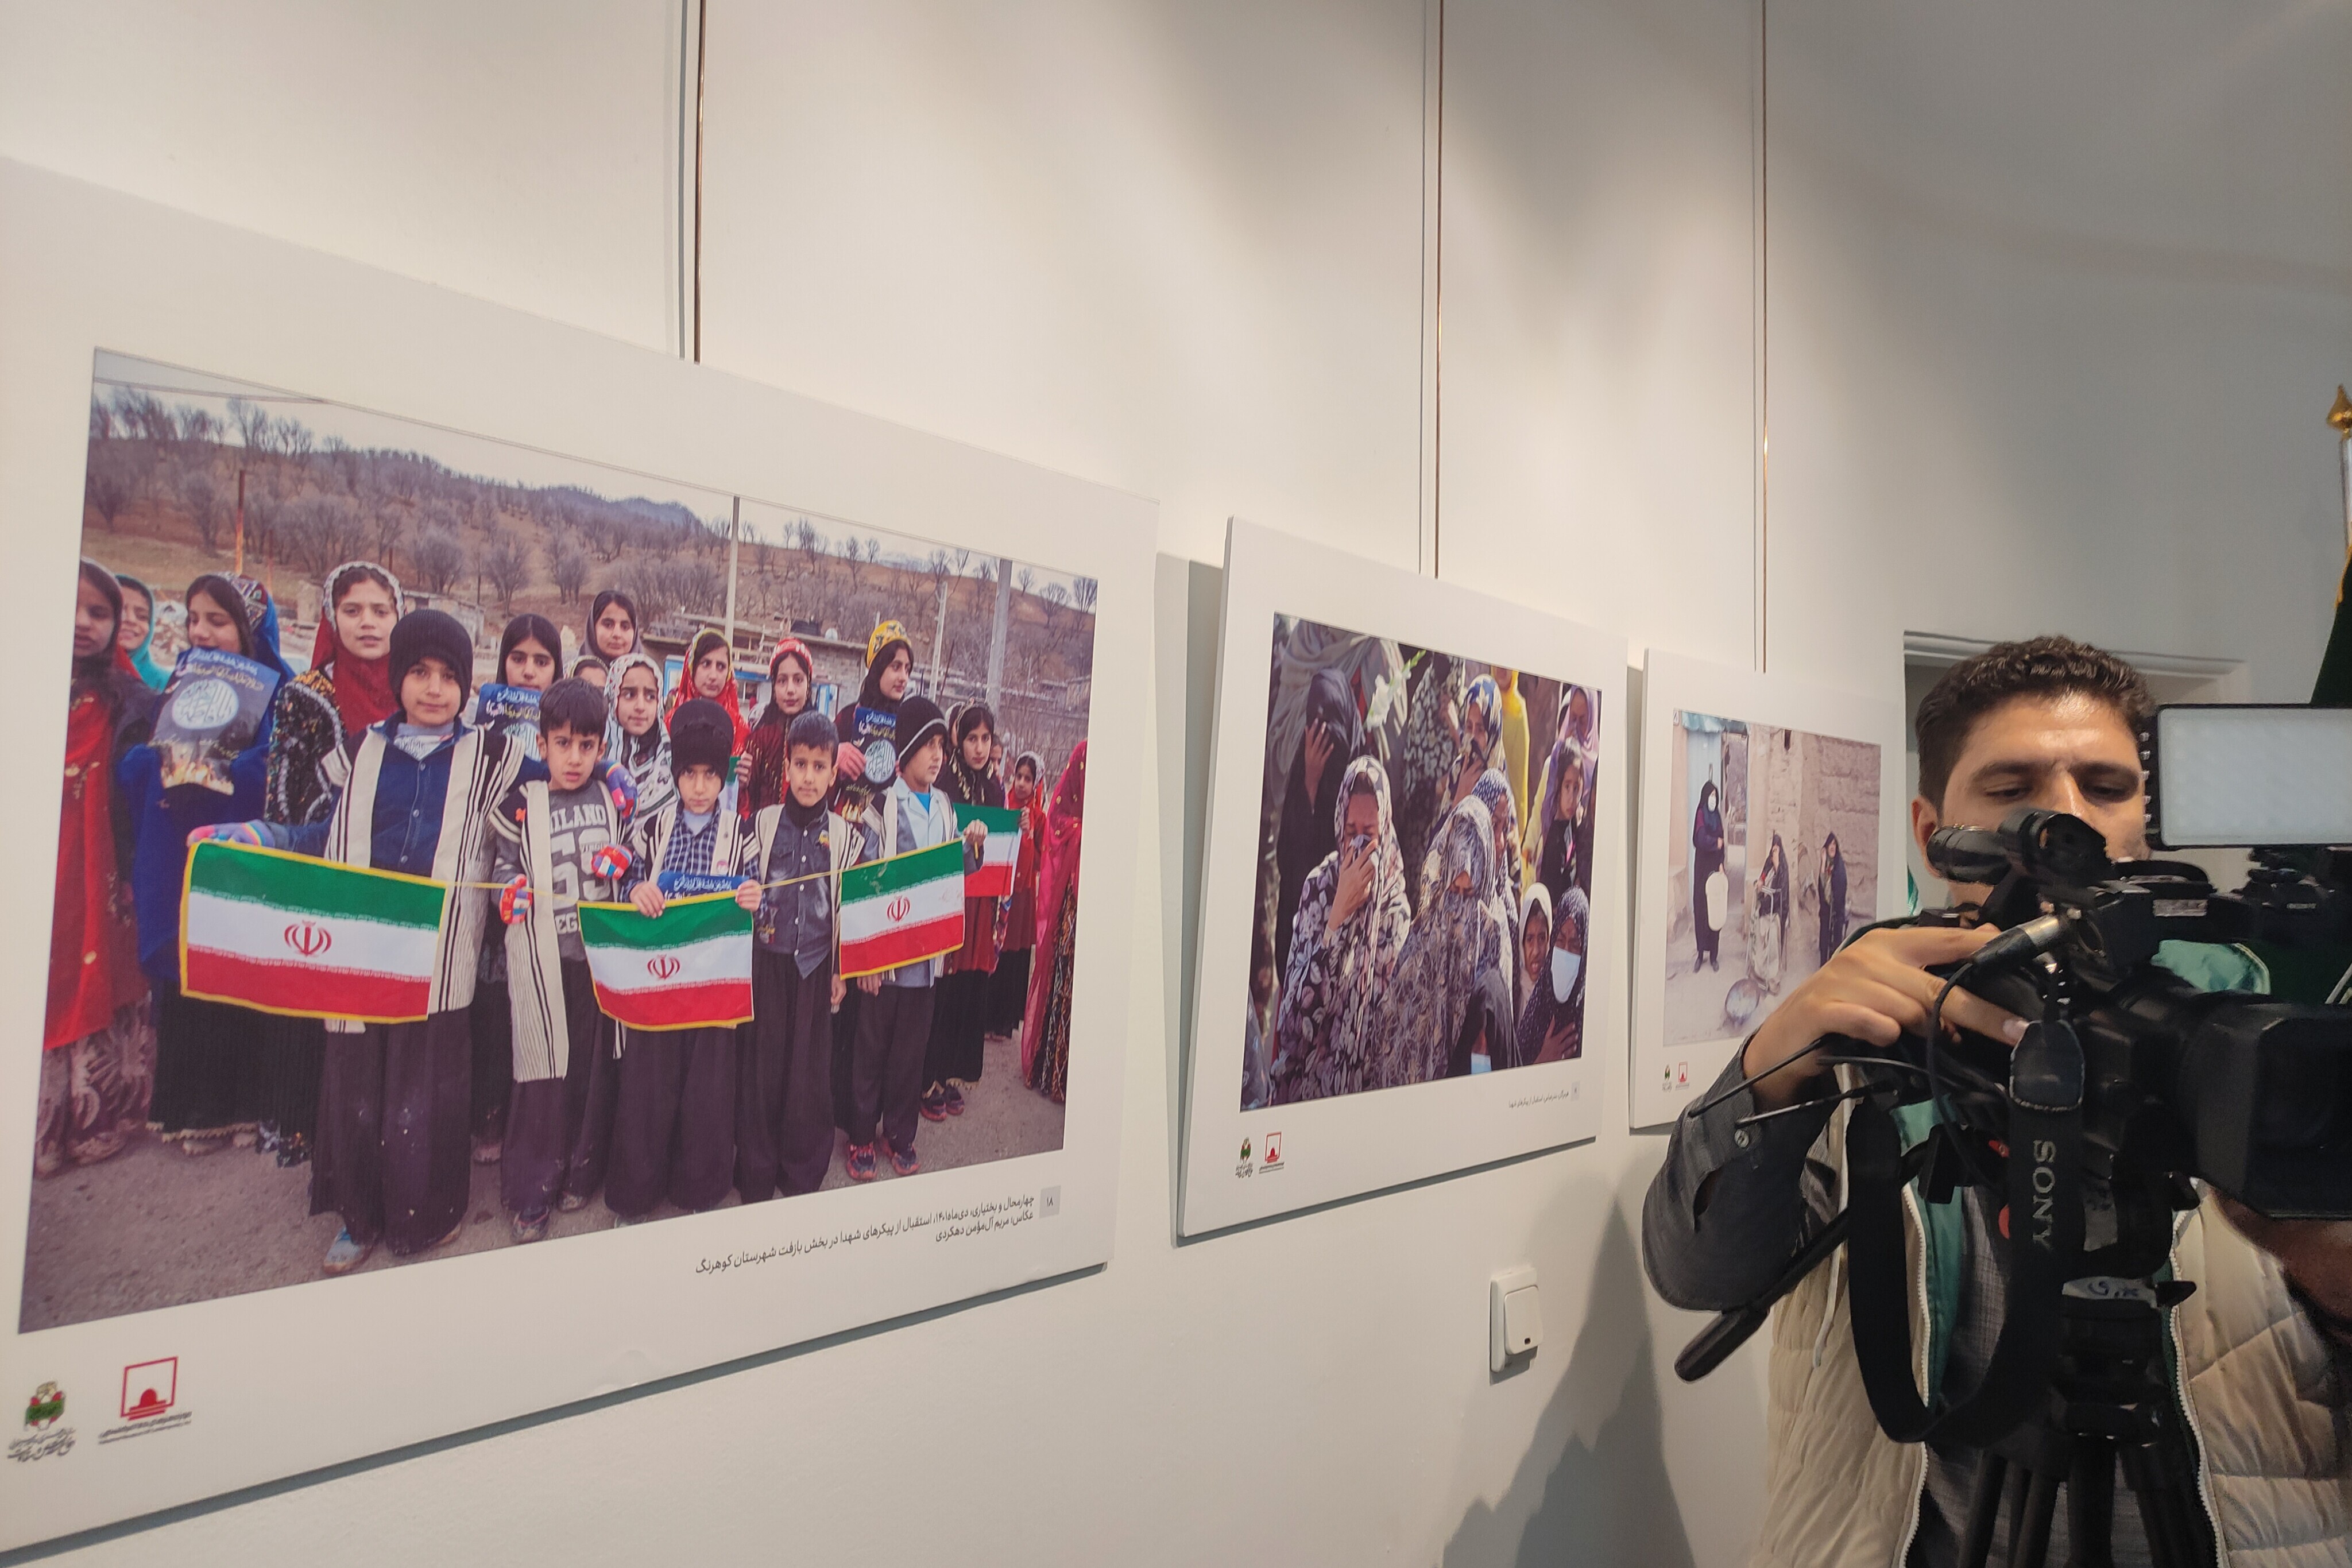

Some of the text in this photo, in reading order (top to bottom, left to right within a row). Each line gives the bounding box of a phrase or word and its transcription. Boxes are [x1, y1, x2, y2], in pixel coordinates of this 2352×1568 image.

[550, 804, 607, 834] ILANO
[555, 912, 579, 935] EG
[1003, 1194, 1034, 1211] چهارمحال
[1046, 1196, 1054, 1207] ۱۸
[2032, 1139, 2056, 1249] SONY
[998, 1202, 1003, 1214] و
[862, 1222, 895, 1240] پیکرهای
[894, 1219, 902, 1235] از
[903, 1213, 932, 1232] استقبال
[994, 1218, 1009, 1232] مریم
[840, 1229, 861, 1245] شهدا
[935, 1225, 965, 1242] دهکردی
[779, 1239, 803, 1257] بازفت
[804, 1237, 828, 1253] بخش
[829, 1236, 838, 1249] در
[695, 1253, 733, 1275] کوهرنگ
[734, 1246, 776, 1268] شهرستان
